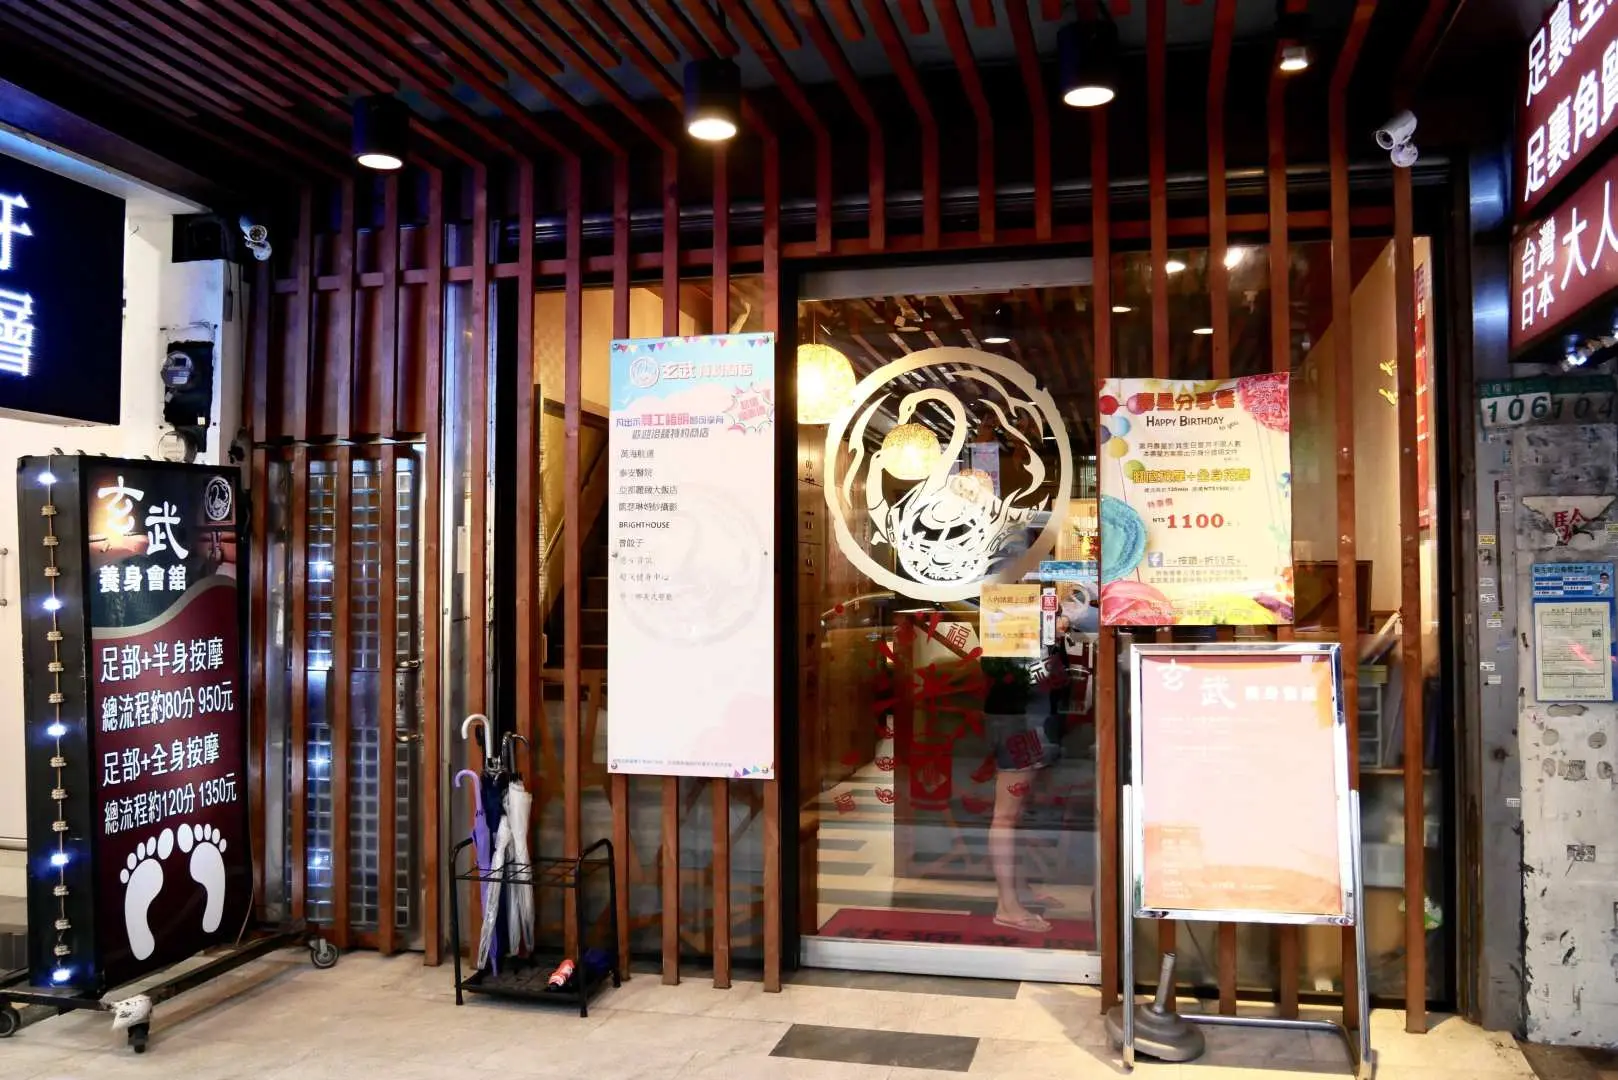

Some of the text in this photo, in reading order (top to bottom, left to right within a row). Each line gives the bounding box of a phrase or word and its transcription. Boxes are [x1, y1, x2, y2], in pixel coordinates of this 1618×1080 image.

[1522, 216, 1556, 285] 台灣
[1522, 272, 1555, 331] 日本
[1487, 396, 1548, 423] 106
[97, 475, 189, 560] 玄武
[618, 521, 671, 529] BRIGHTHOUSE
[1167, 513, 1225, 529] 1100
[101, 636, 224, 683] 足部+半身按摩
[102, 681, 234, 733] 總流程約80分 950元
[102, 732, 220, 787] 足部+全身按摩
[104, 772, 237, 836] 總流程約120分 1350元
